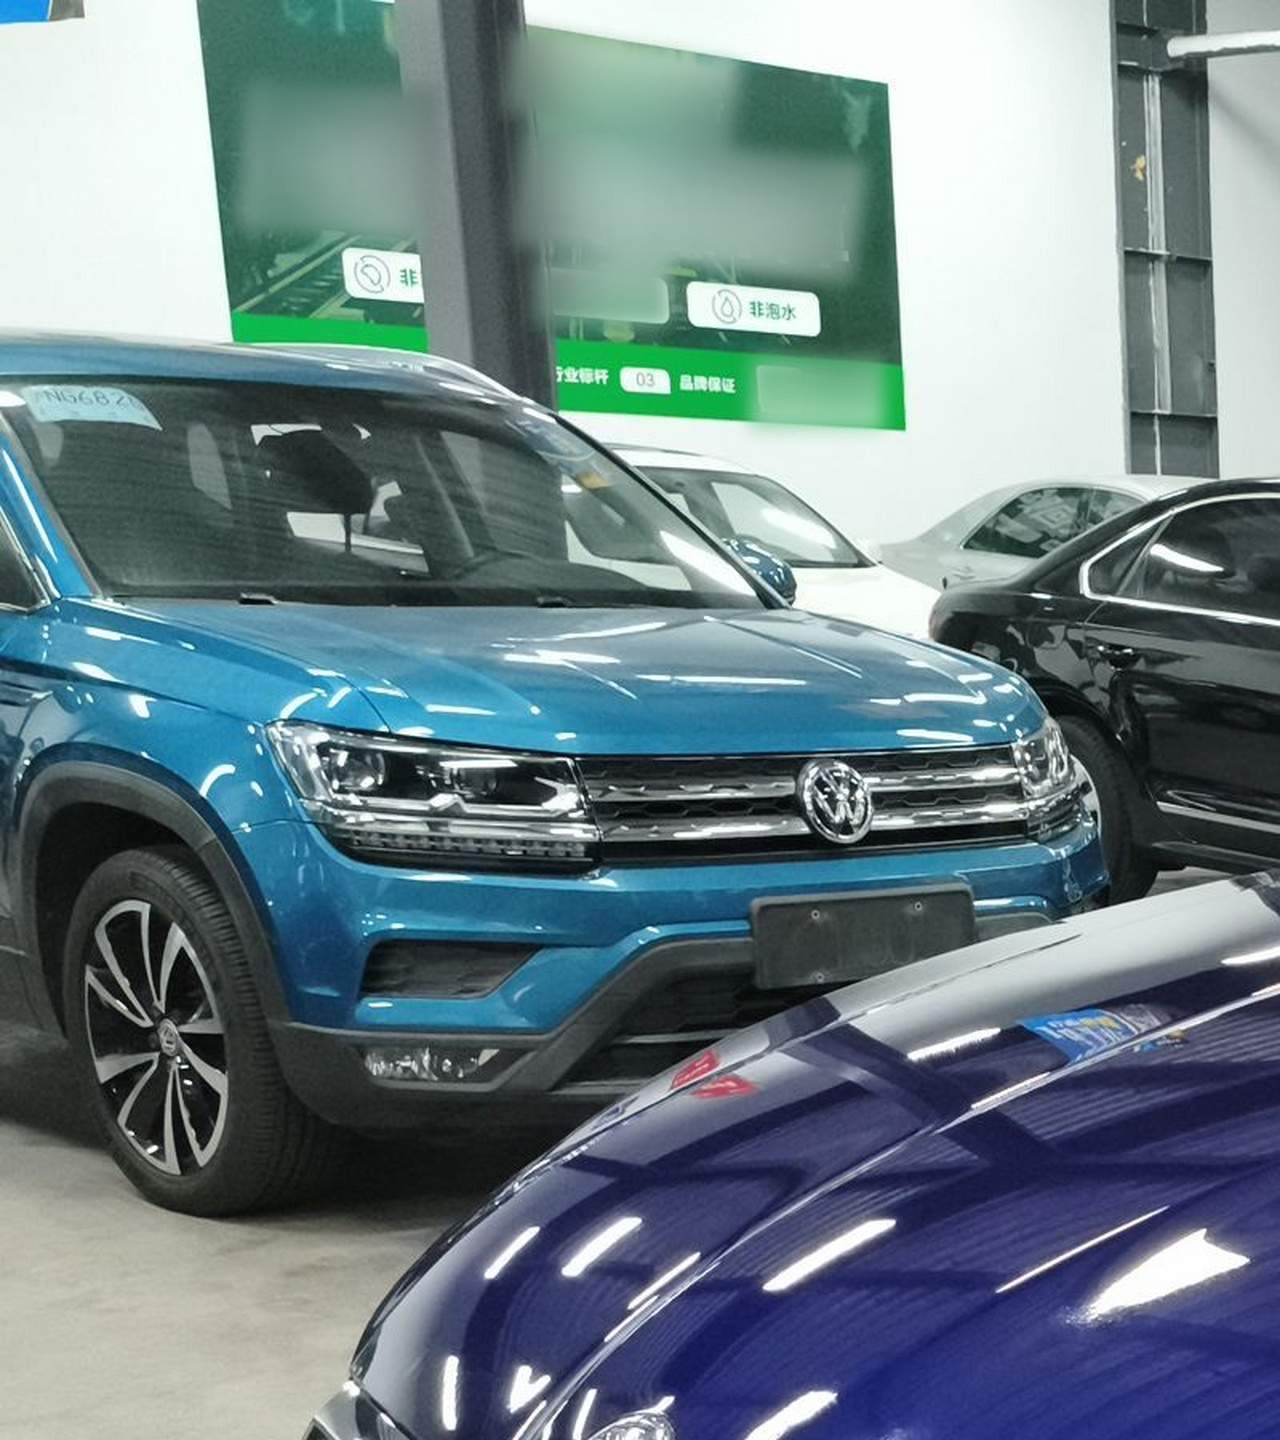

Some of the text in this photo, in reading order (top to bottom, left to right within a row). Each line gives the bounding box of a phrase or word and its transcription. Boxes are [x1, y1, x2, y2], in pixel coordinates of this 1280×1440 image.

[749, 300, 796, 322] 非泡水
[635, 372, 656, 388] 03
[679, 374, 736, 394] 品牌保证
